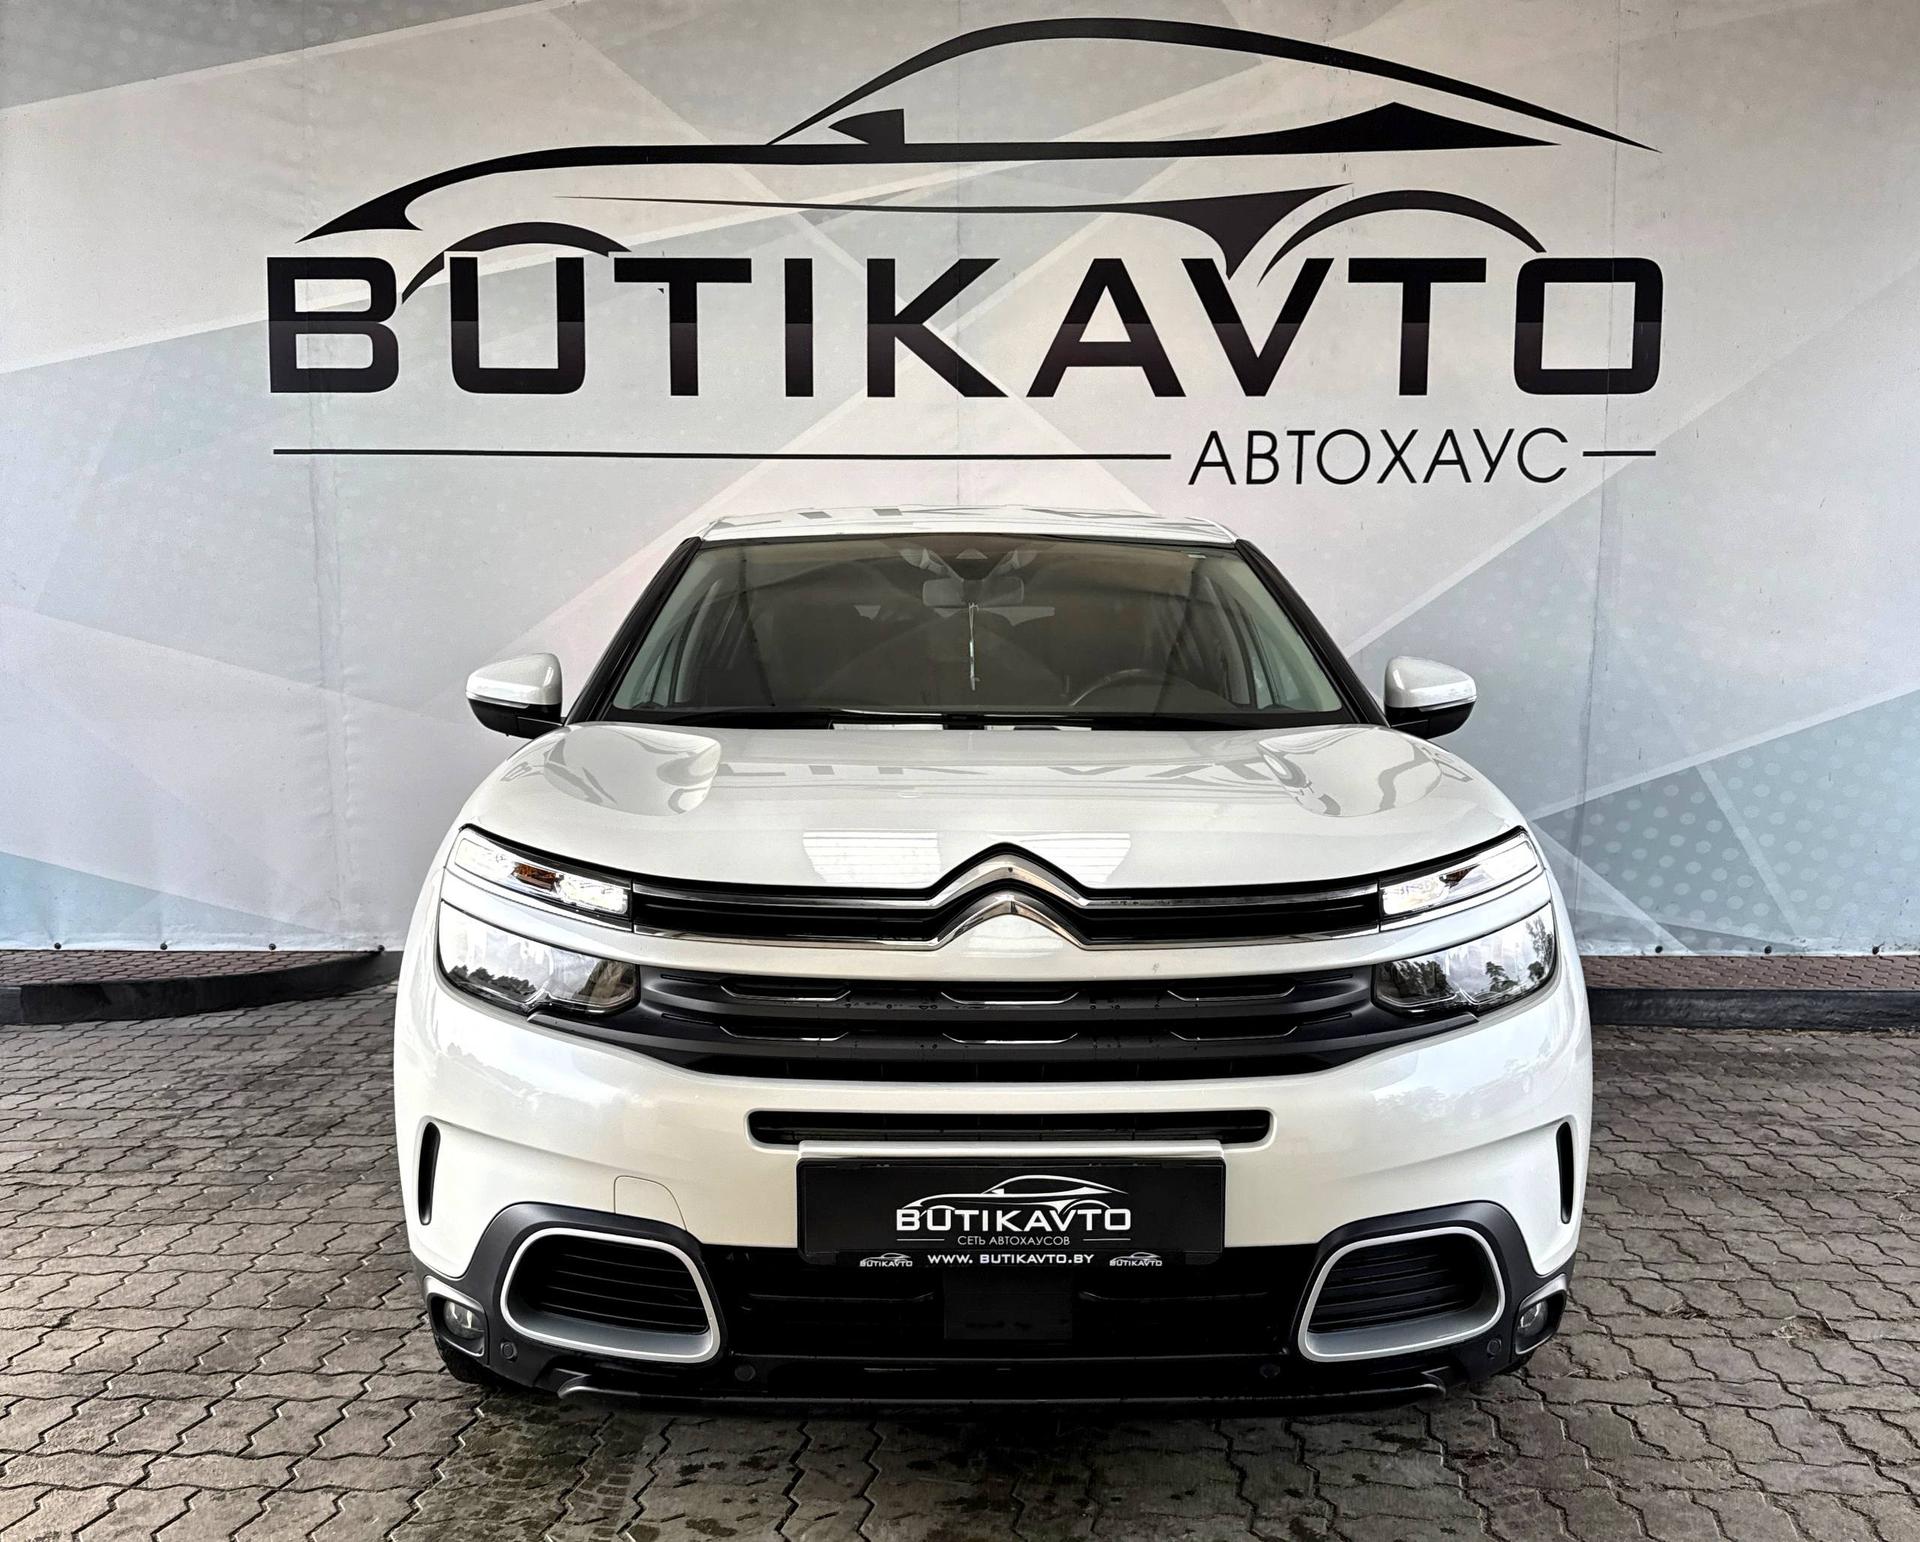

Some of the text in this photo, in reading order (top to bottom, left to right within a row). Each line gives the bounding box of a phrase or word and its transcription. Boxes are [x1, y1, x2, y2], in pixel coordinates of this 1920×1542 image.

[267, 256, 1664, 397] BUTIKAVTO
[1187, 427, 1569, 486] АВТОХАУС
[895, 1208, 1132, 1232] BUTIKAVTO
[957, 1235, 1071, 1246] СЕТЬ АВТОХАУСОВ
[859, 1259, 913, 1268] BUTIKAVTO
[979, 1253, 1095, 1265] BUTIKAVTO.BY
[1109, 1259, 1163, 1267] BUTIKAVTO
